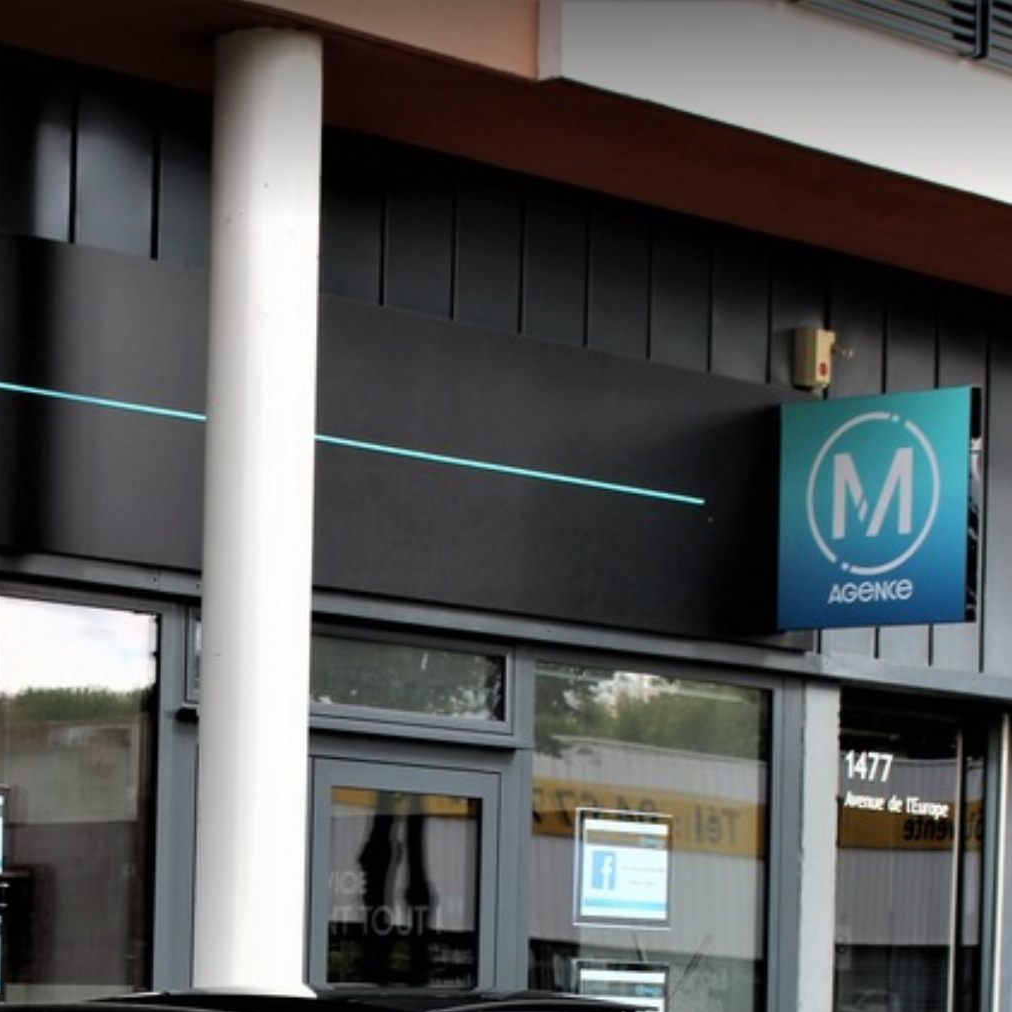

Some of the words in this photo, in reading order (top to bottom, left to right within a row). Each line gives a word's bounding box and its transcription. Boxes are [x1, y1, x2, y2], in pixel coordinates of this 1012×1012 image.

[831, 446, 915, 540] M
[828, 578, 914, 604] AGENCE
[844, 749, 894, 783] 1477
[844, 790, 886, 811] Avenue
[887, 795, 904, 813] de
[906, 796, 950, 820] l'Europe
